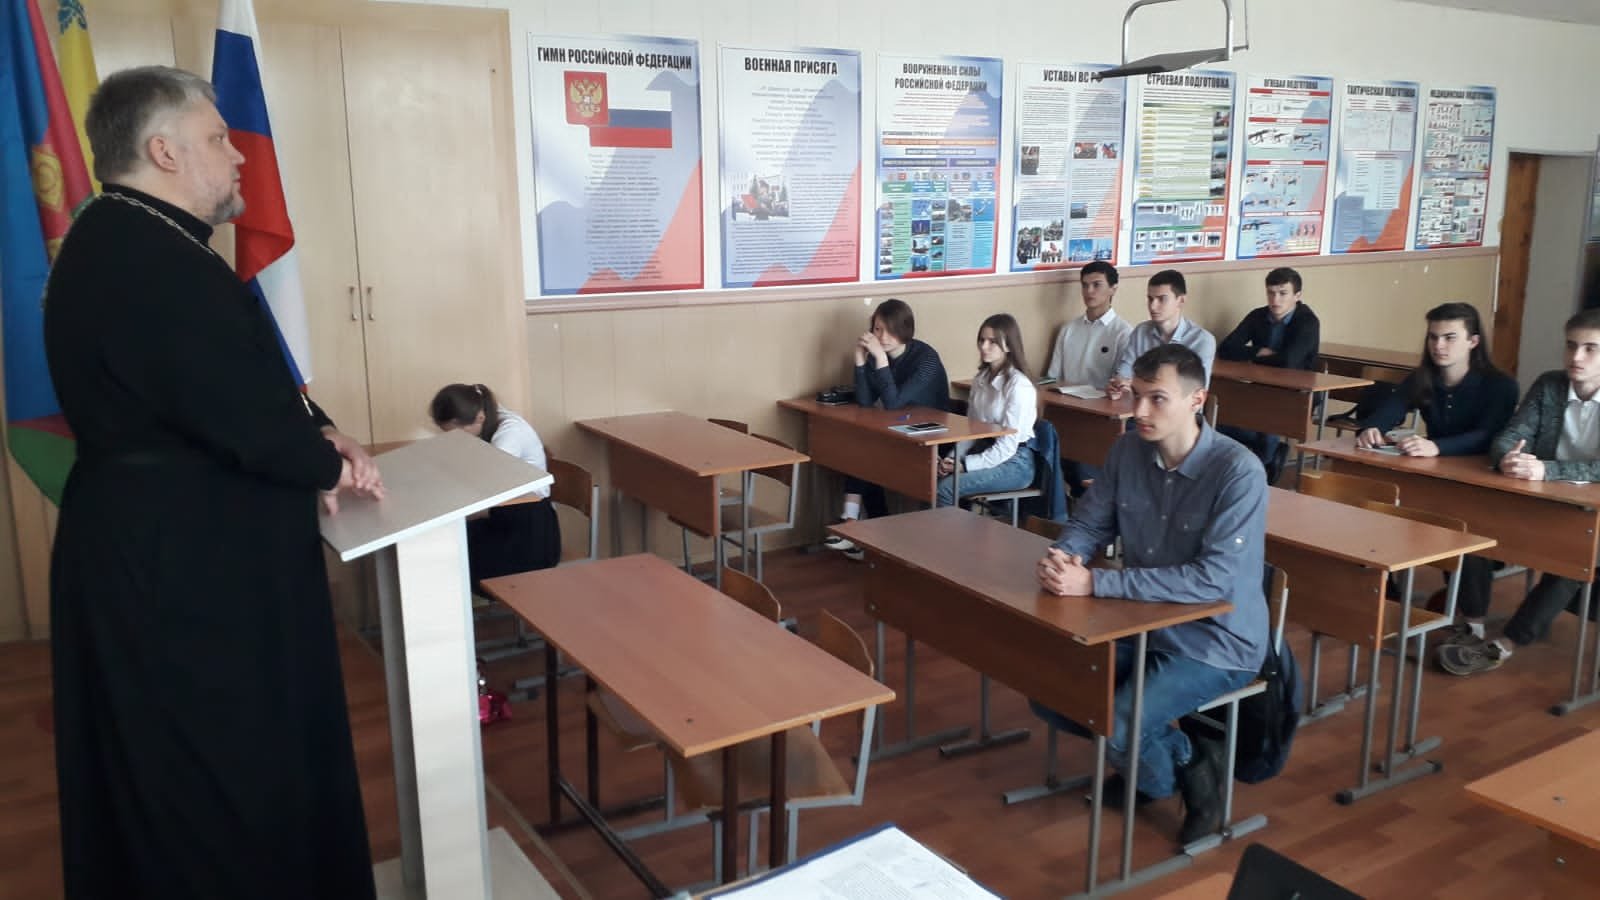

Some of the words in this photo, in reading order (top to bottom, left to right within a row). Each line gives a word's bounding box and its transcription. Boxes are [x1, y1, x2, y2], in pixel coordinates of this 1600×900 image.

[538, 47, 565, 62] ГИМН
[568, 48, 633, 66] РОССИЙСКОЙ
[636, 52, 692, 71] ФЕДЕРАЦИИ
[745, 57, 791, 72] ВОЕННАЯ
[794, 60, 837, 75] ПРИСЯГА
[903, 63, 957, 76] ВООРУЖЕННЫЕ
[959, 66, 981, 77] СИЛЫ
[1043, 70, 1076, 82] УСТАВЫ
[1079, 71, 1089, 83] ВС
[895, 77, 943, 90] РОССИЙСКОЙ
[945, 79, 987, 92] ФЕДЕРАЦИИ
[1147, 73, 1183, 86] СТРОЕВАЯ
[1185, 75, 1229, 88] ПОДГОТОВКА
